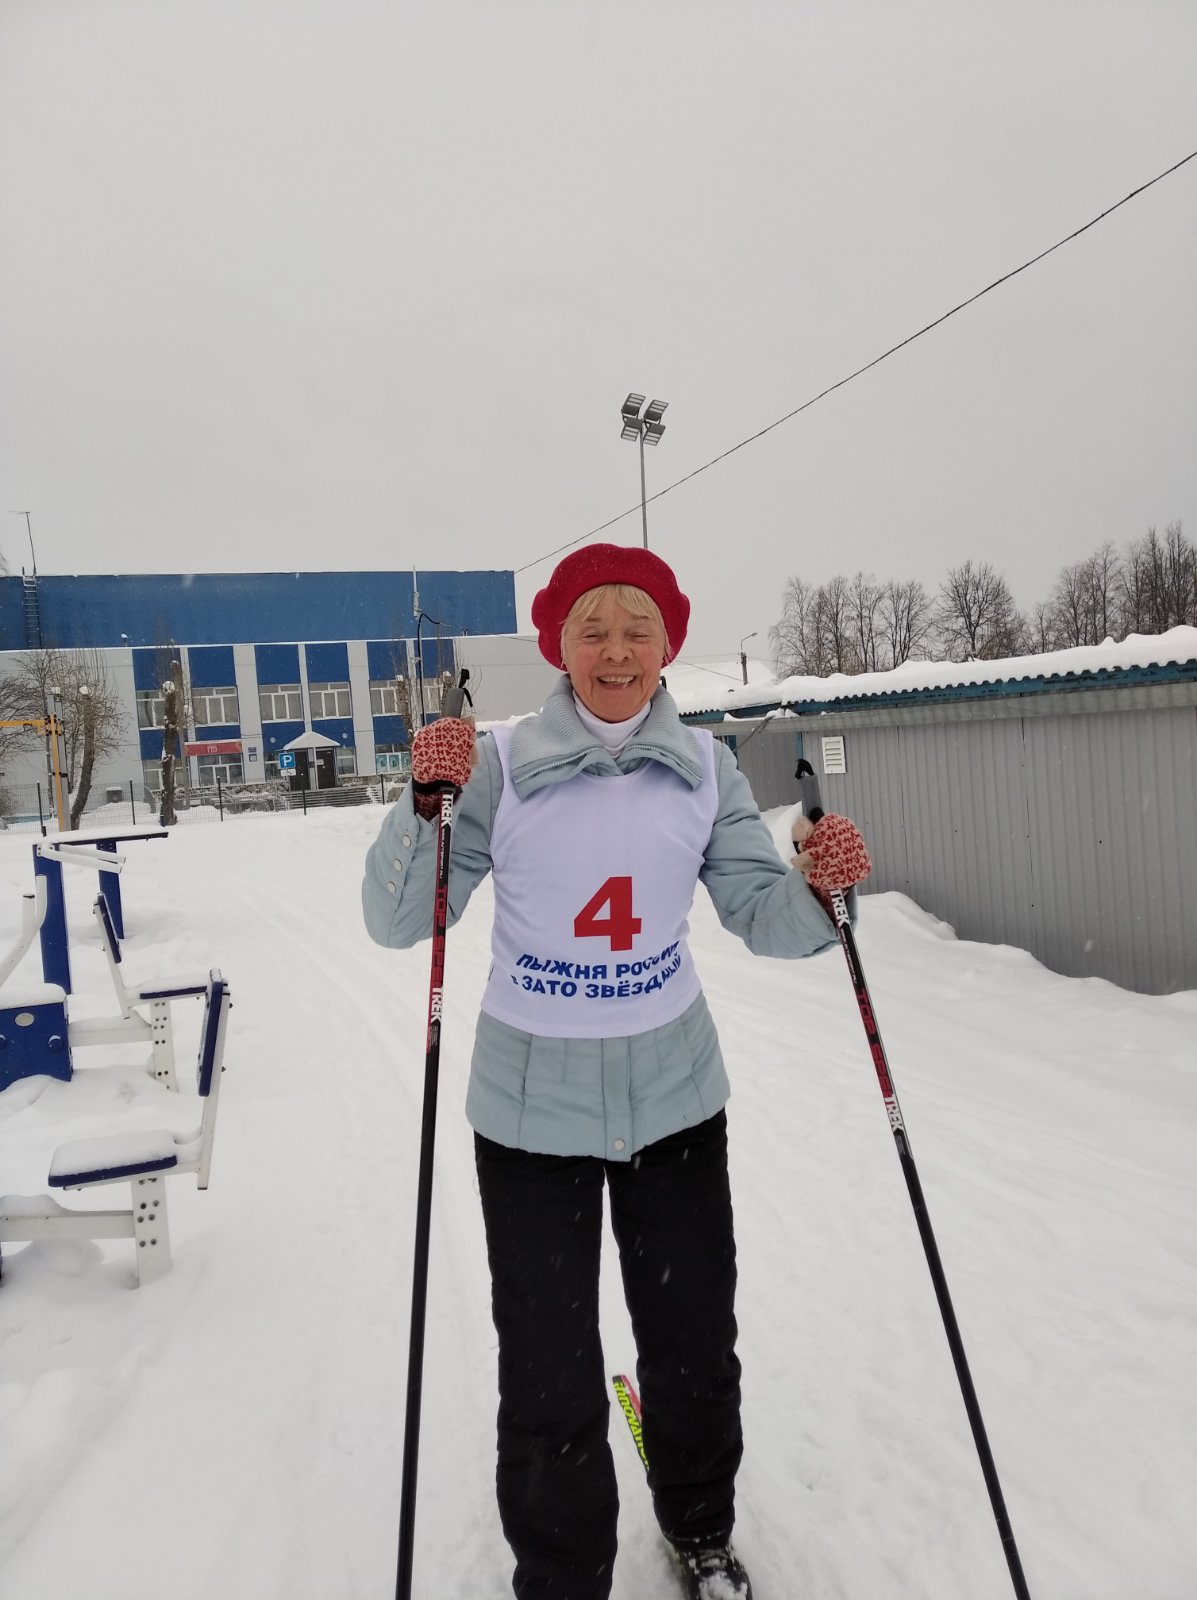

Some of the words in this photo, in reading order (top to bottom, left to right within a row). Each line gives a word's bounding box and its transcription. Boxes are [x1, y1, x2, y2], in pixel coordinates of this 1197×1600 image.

[283, 755, 292, 766] P
[441, 791, 453, 828] TREK
[435, 884, 447, 927] TOP
[574, 876, 642, 951] 4
[830, 888, 850, 928] TREK
[516, 954, 607, 979] ЛЫЖНЯ
[522, 975, 577, 997] ЗАТО
[585, 952, 681, 998] ЗВЁЗДНЫЙ
[431, 986, 444, 1023] TREK
[858, 988, 876, 1034] TOP
[884, 1094, 904, 1132] TREK
